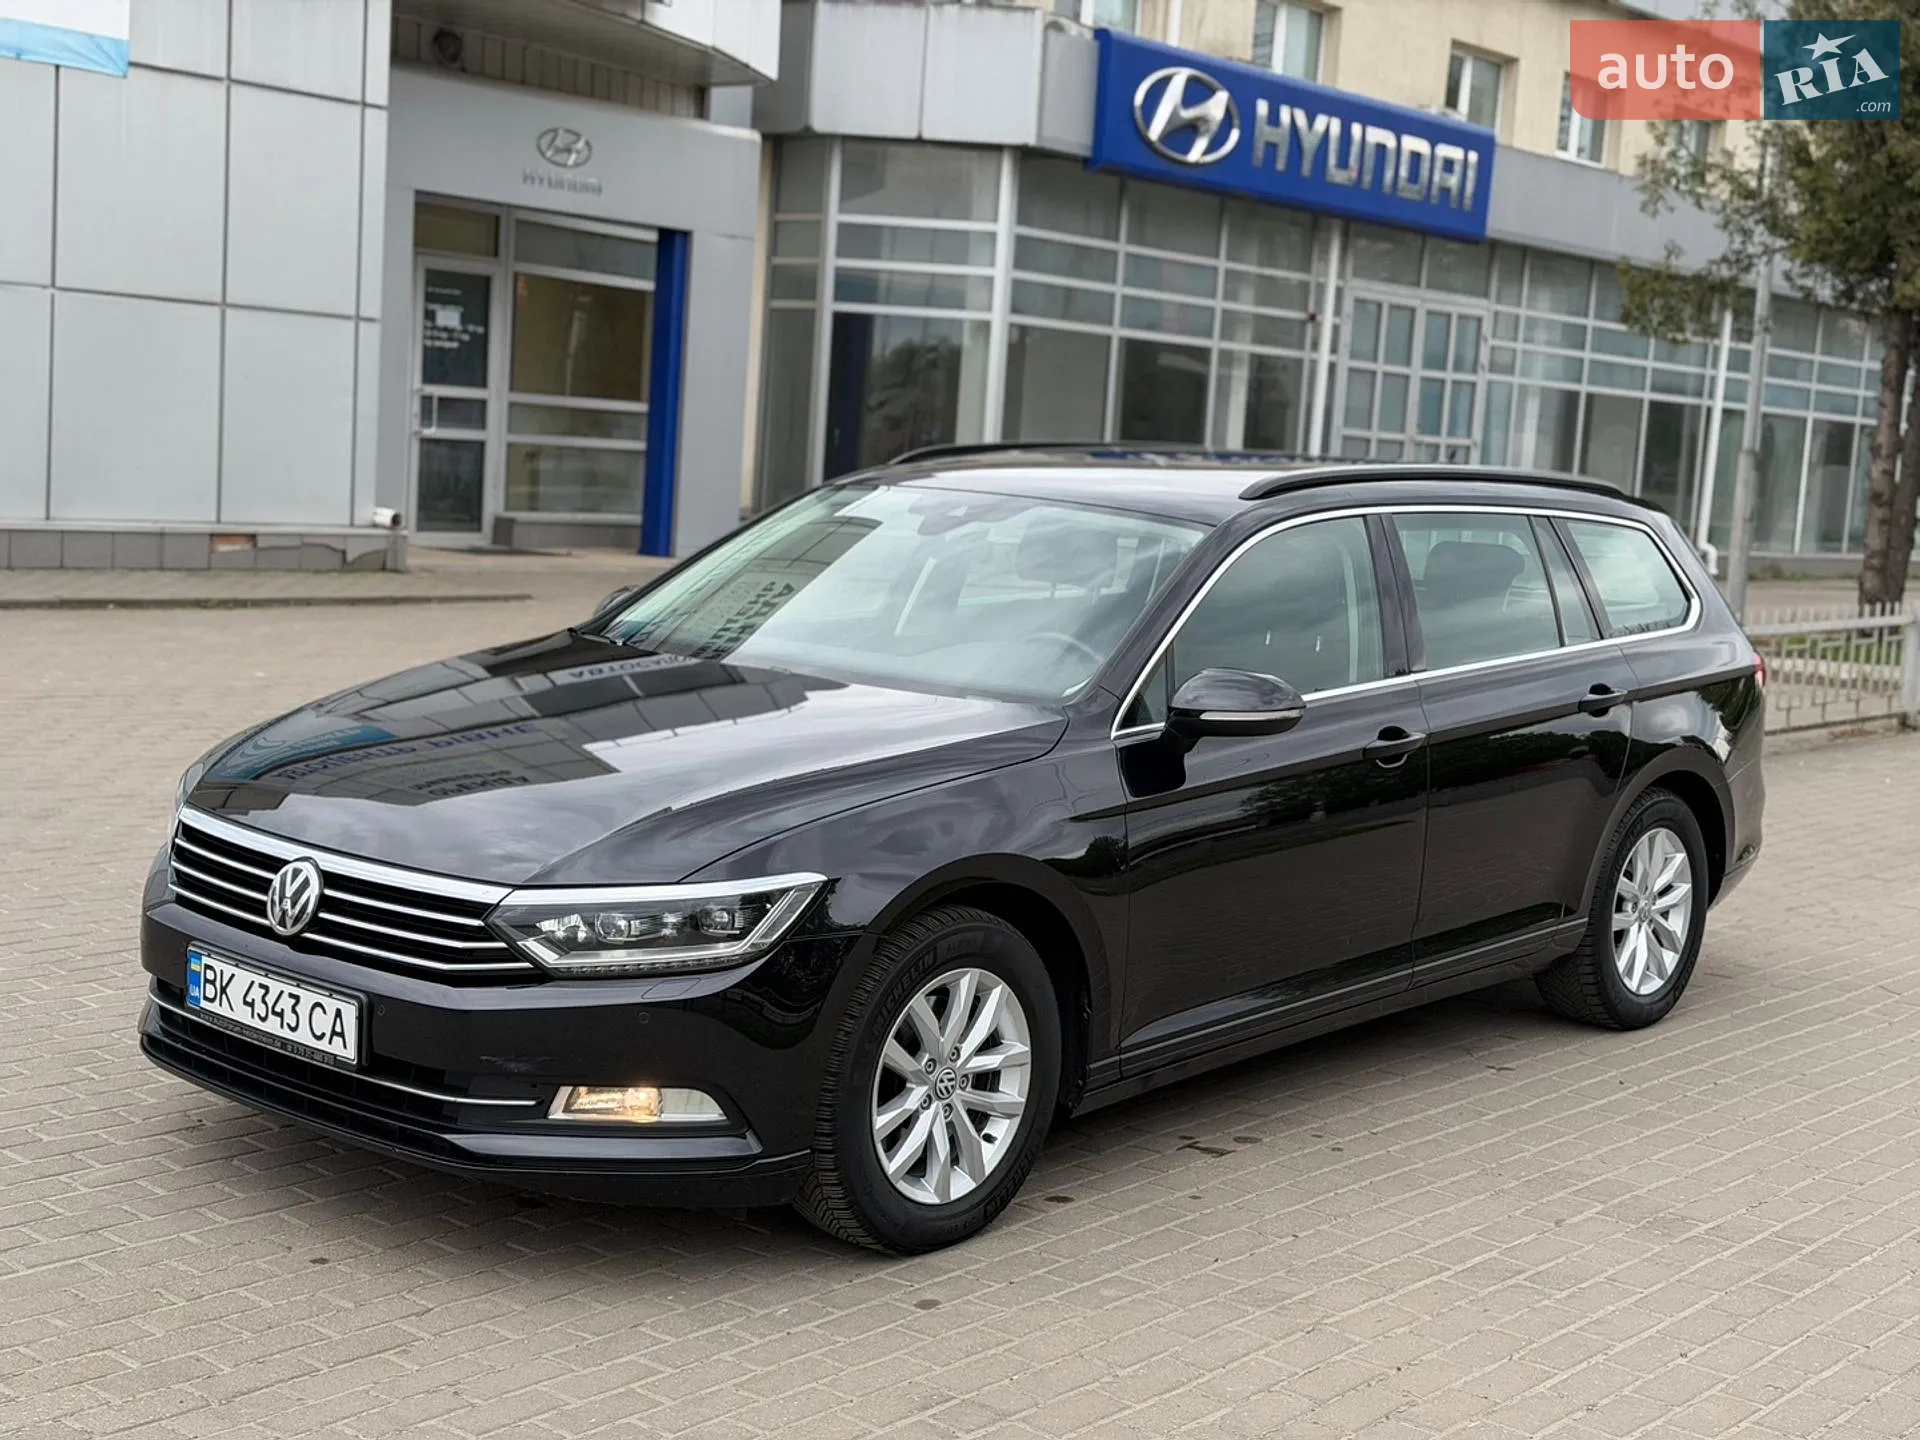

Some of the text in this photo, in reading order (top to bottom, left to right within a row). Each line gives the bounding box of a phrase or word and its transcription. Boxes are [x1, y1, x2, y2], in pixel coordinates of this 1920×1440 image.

[1253, 98, 1479, 211] HYUNDAI
[189, 985, 201, 998] UA
[202, 962, 236, 1012] BK
[243, 979, 301, 1034] 4343
[308, 1001, 348, 1050] CA
